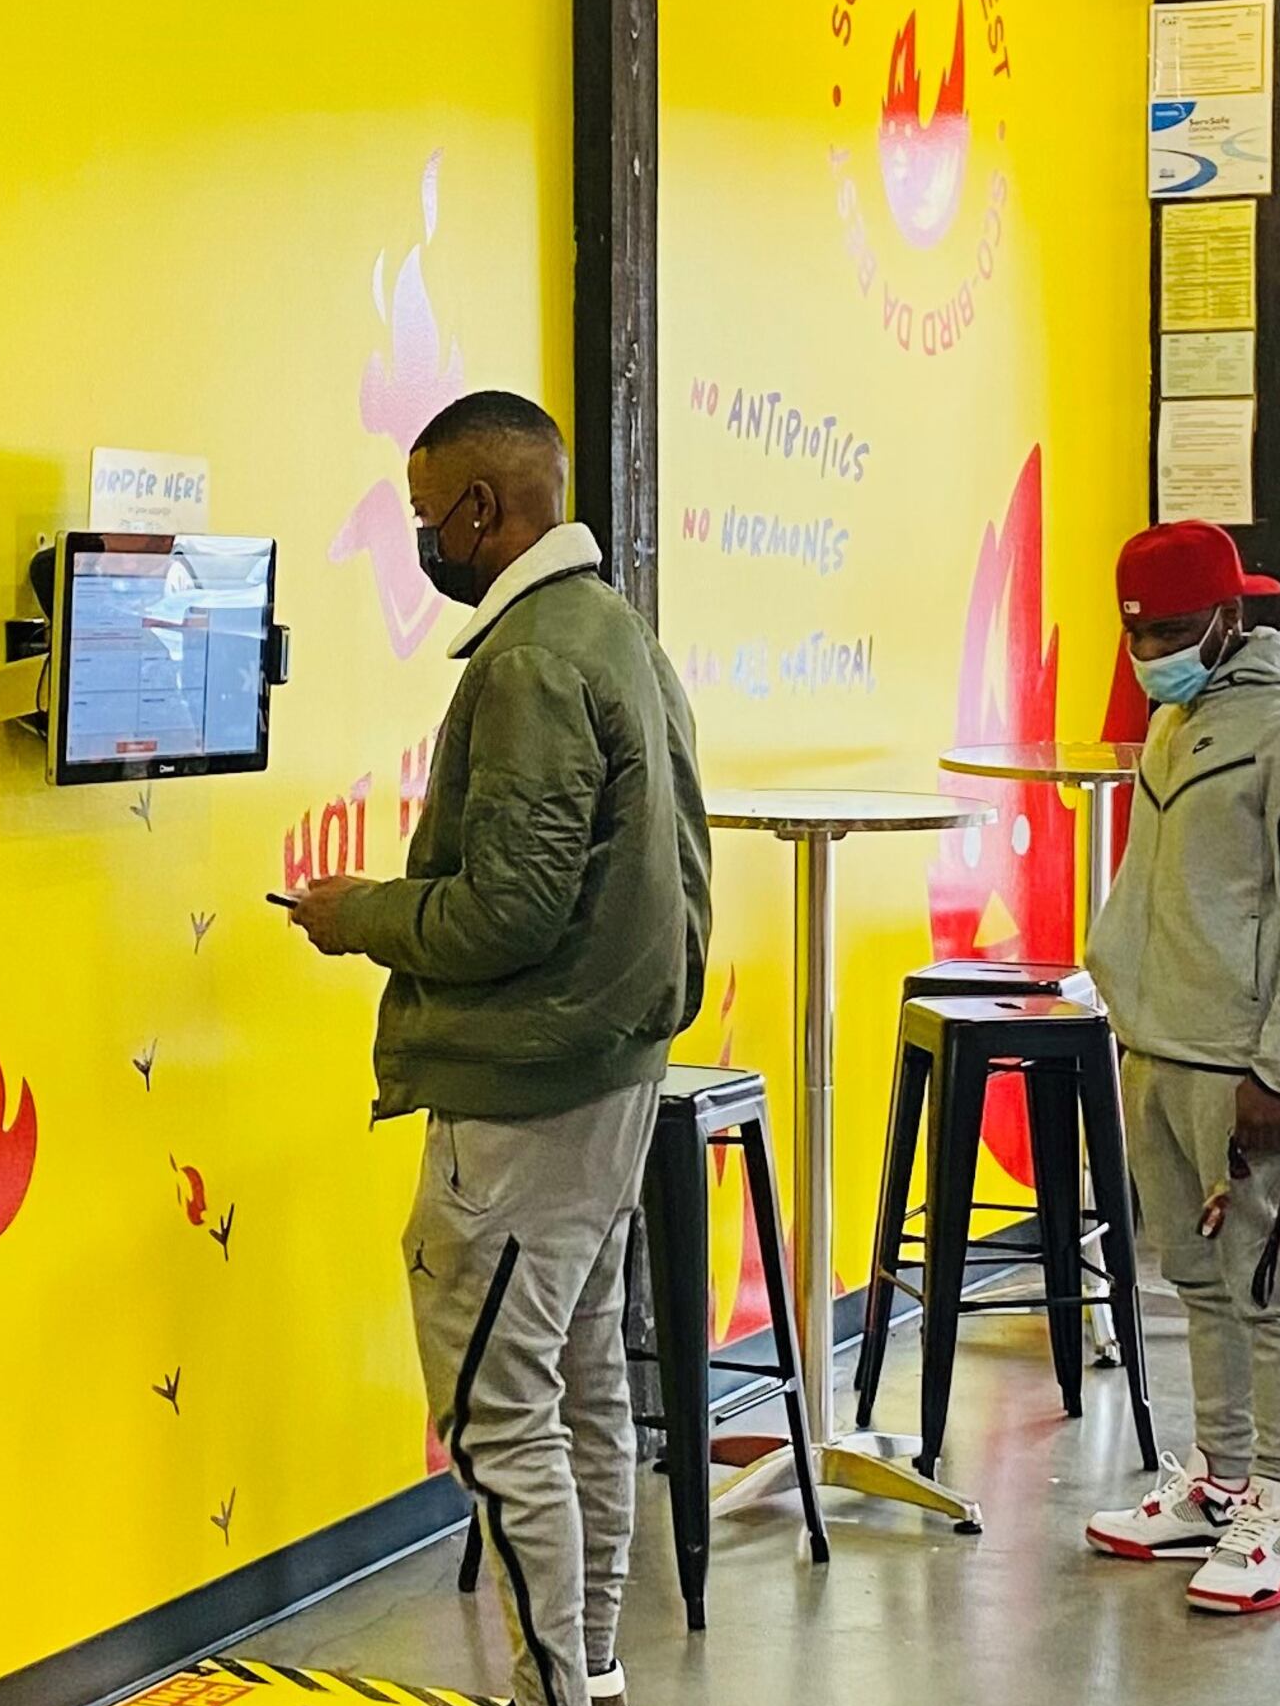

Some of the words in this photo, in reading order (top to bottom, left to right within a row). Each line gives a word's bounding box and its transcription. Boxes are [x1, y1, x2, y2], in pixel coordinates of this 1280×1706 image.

[690, 376, 719, 417] NO
[727, 387, 870, 482] ANTIBIOTICS
[94, 467, 157, 499] ORDER
[164, 471, 205, 503] HERE
[683, 507, 710, 543] NO
[721, 504, 850, 576] HORMONES
[284, 771, 372, 905] HOT
